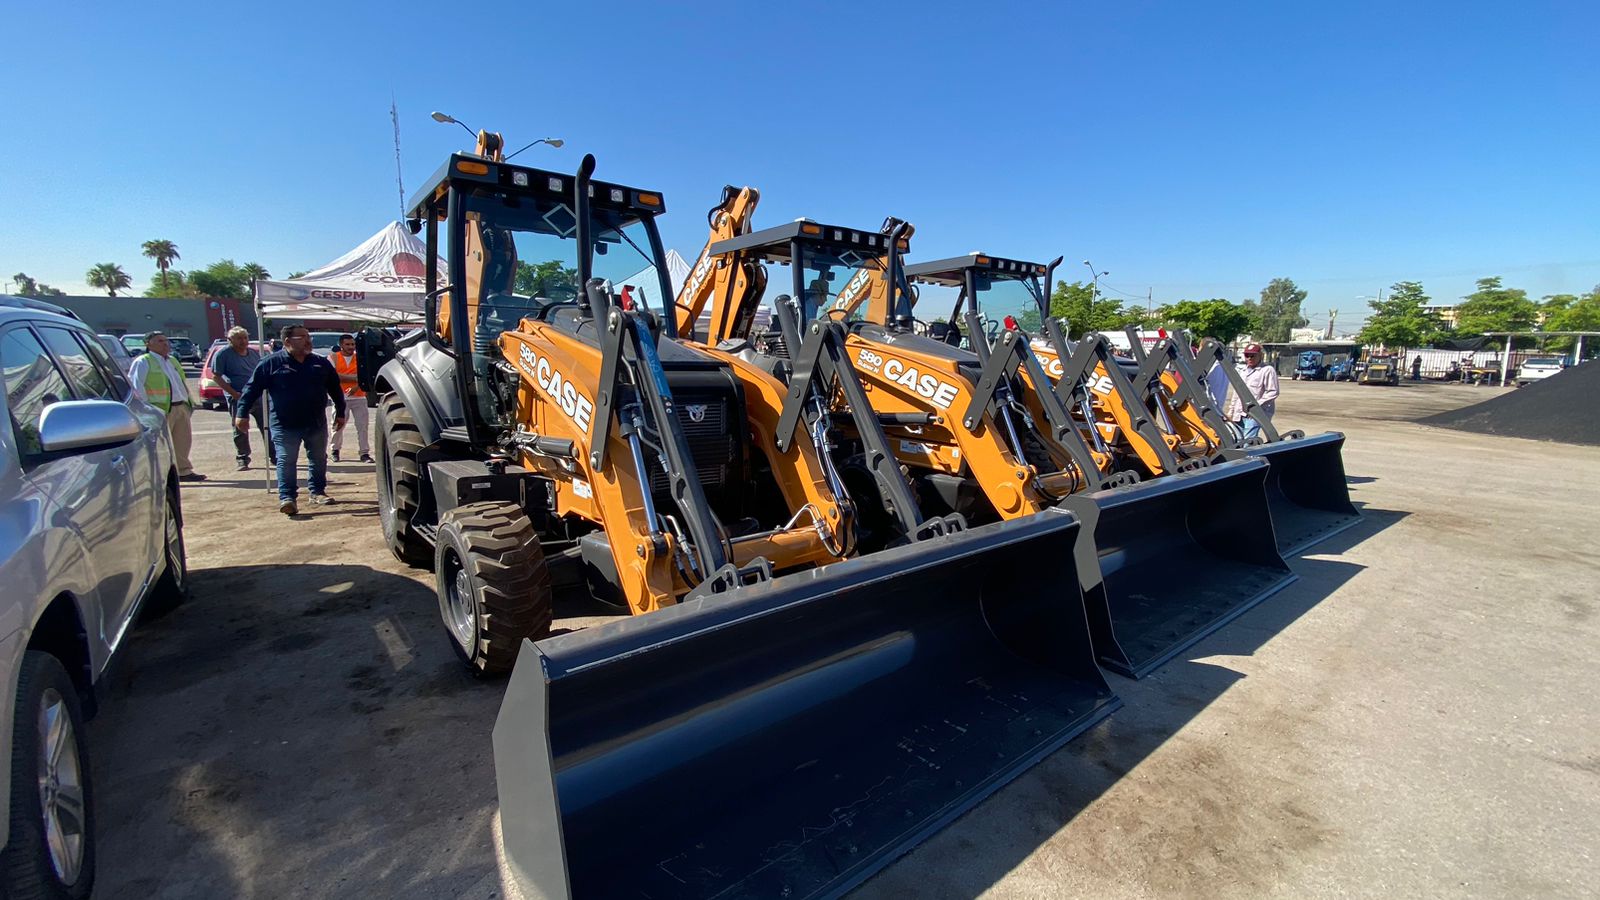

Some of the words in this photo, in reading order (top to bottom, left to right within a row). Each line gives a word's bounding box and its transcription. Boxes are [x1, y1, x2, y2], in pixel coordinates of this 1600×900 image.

[311, 290, 366, 300] CESPM
[683, 249, 712, 311] CASE
[835, 268, 870, 310] CASE
[519, 341, 537, 368] 580
[859, 347, 884, 368] 580
[537, 356, 593, 435] CASE
[883, 358, 960, 409] CASE
